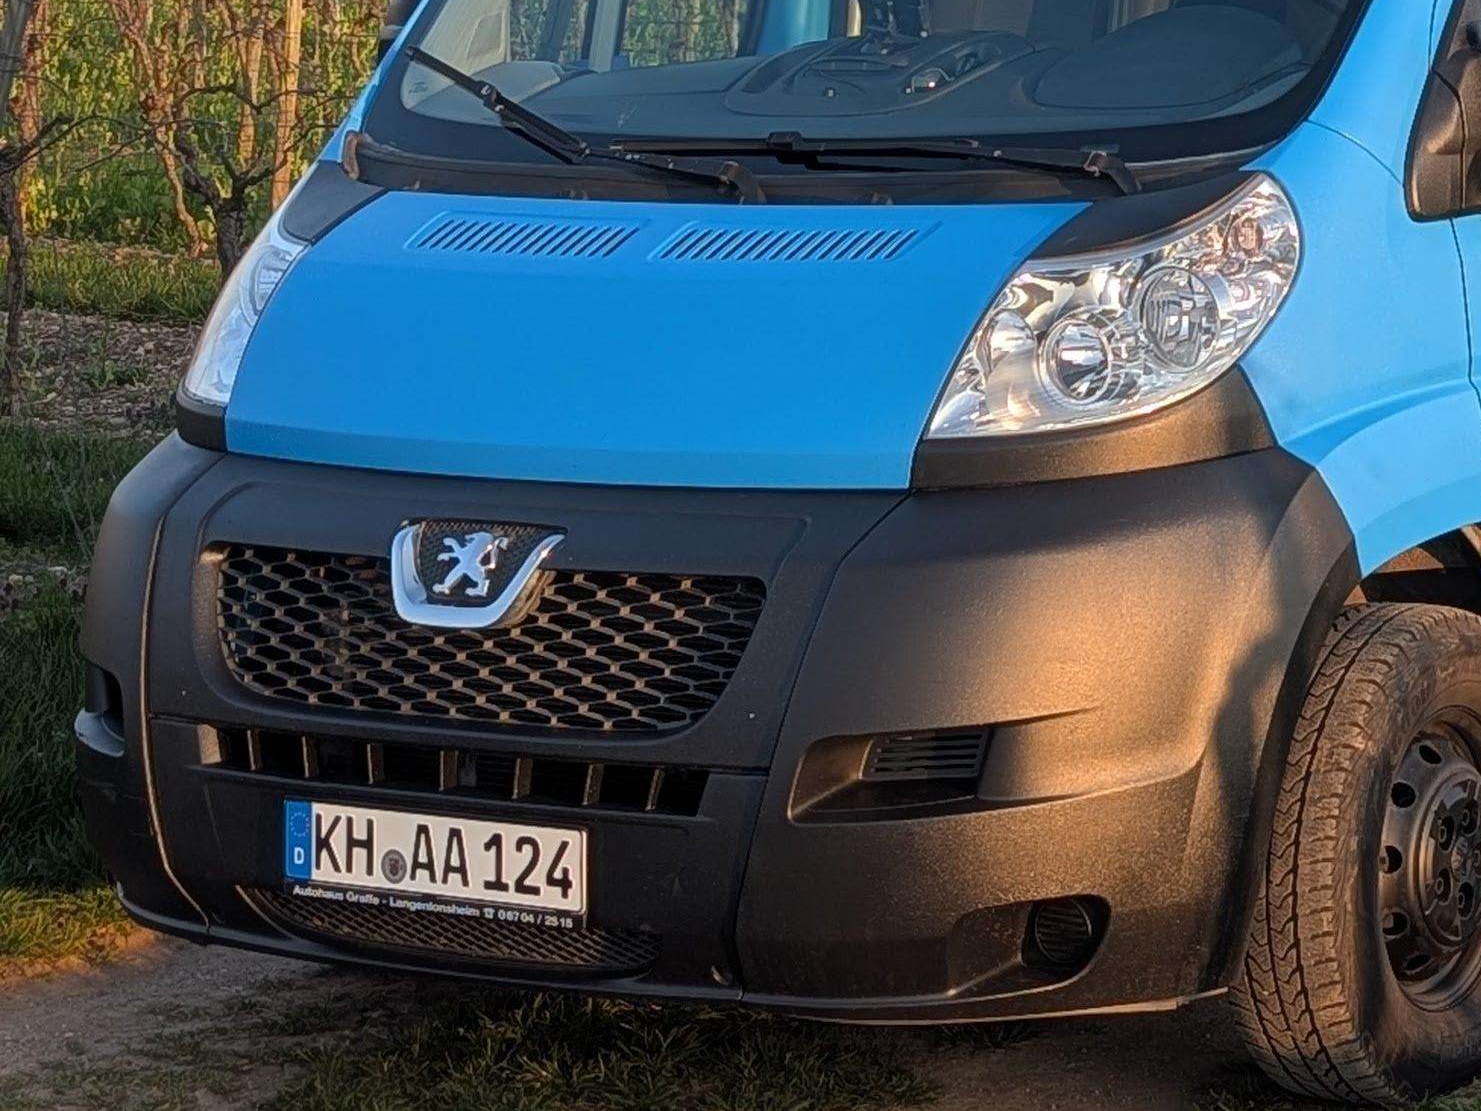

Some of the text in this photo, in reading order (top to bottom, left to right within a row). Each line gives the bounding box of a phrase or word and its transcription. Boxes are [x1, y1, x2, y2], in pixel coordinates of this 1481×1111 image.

[294, 847, 304, 865] D
[315, 813, 572, 899] KH AA 124
[293, 884, 344, 901] Autohaus
